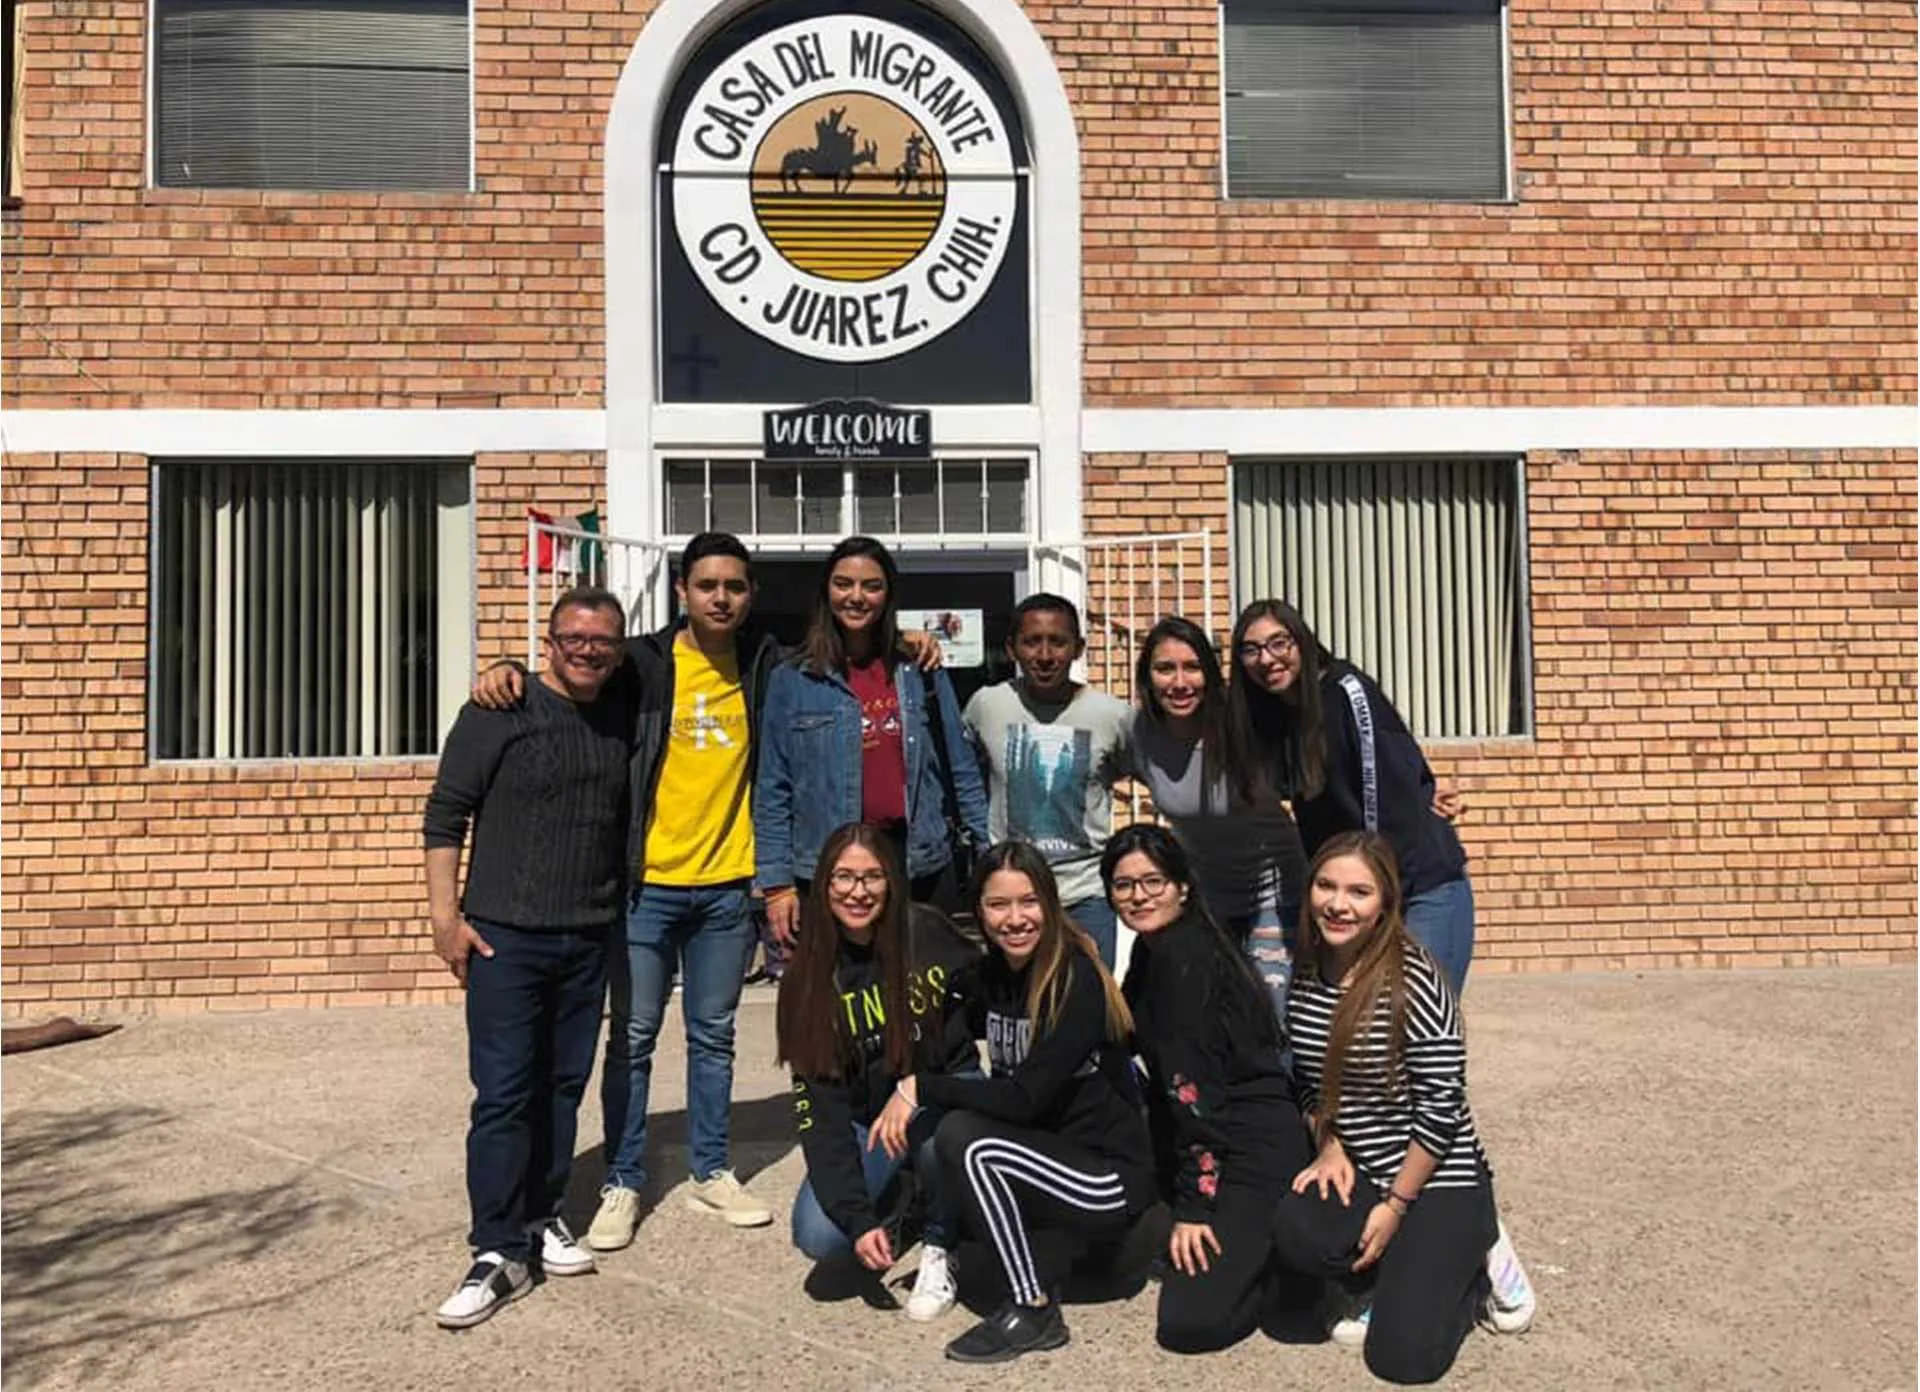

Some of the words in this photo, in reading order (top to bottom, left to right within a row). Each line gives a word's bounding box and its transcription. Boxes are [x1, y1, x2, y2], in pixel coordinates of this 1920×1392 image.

[693, 60, 784, 161] CASA
[774, 32, 835, 89] DEL
[850, 29, 995, 154] MIGRANTE
[699, 222, 762, 303] CD.
[763, 284, 929, 347] JUAREZ,
[927, 215, 1002, 303] CHIH.
[772, 413, 922, 445] WELCOME
